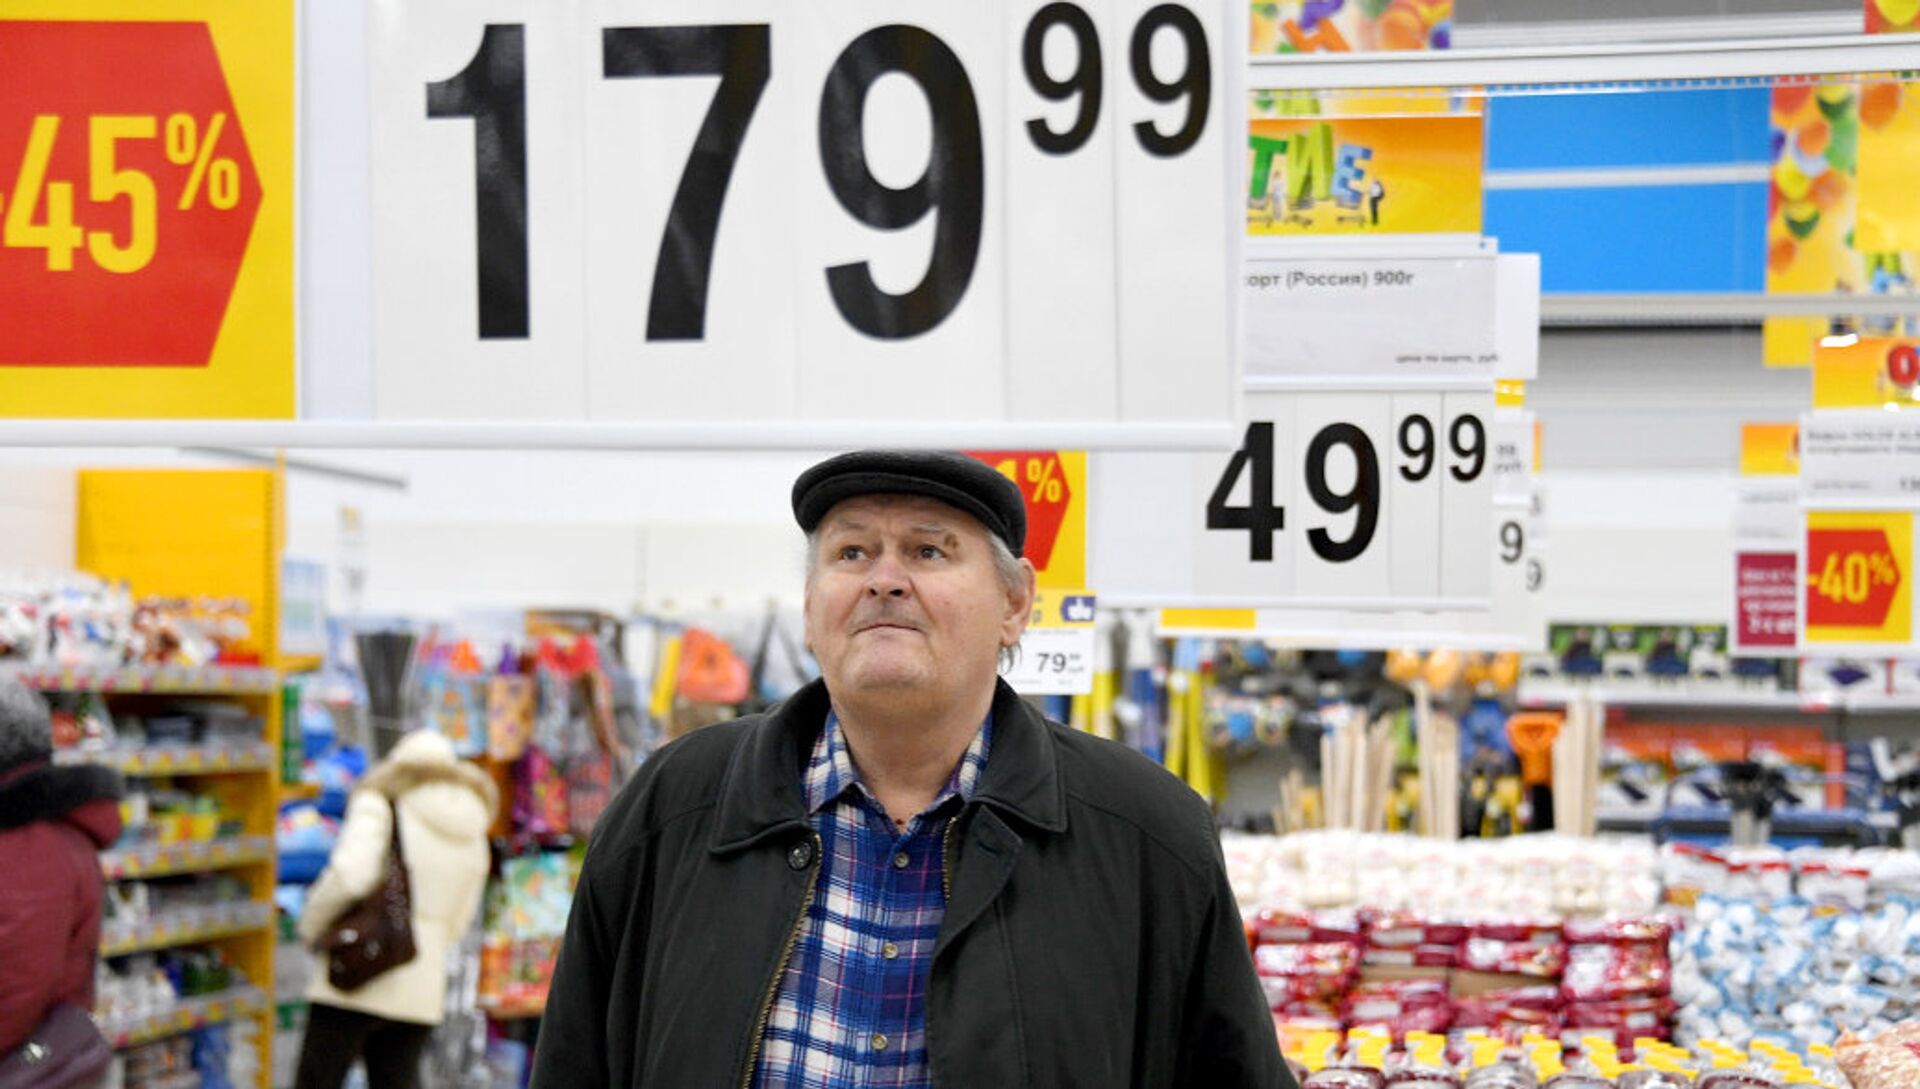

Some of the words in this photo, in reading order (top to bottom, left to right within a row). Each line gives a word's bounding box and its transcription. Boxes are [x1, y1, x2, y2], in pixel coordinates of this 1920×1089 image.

[0, 112, 241, 274] 45%
[425, 24, 985, 342] 179
[1021, 1, 1213, 160] 99
[1245, 273, 1280, 288] орт
[1286, 271, 1368, 290] (Россия)
[1373, 271, 1414, 286] 900г
[1206, 421, 1380, 563] 49
[1397, 413, 1487, 483] 99
